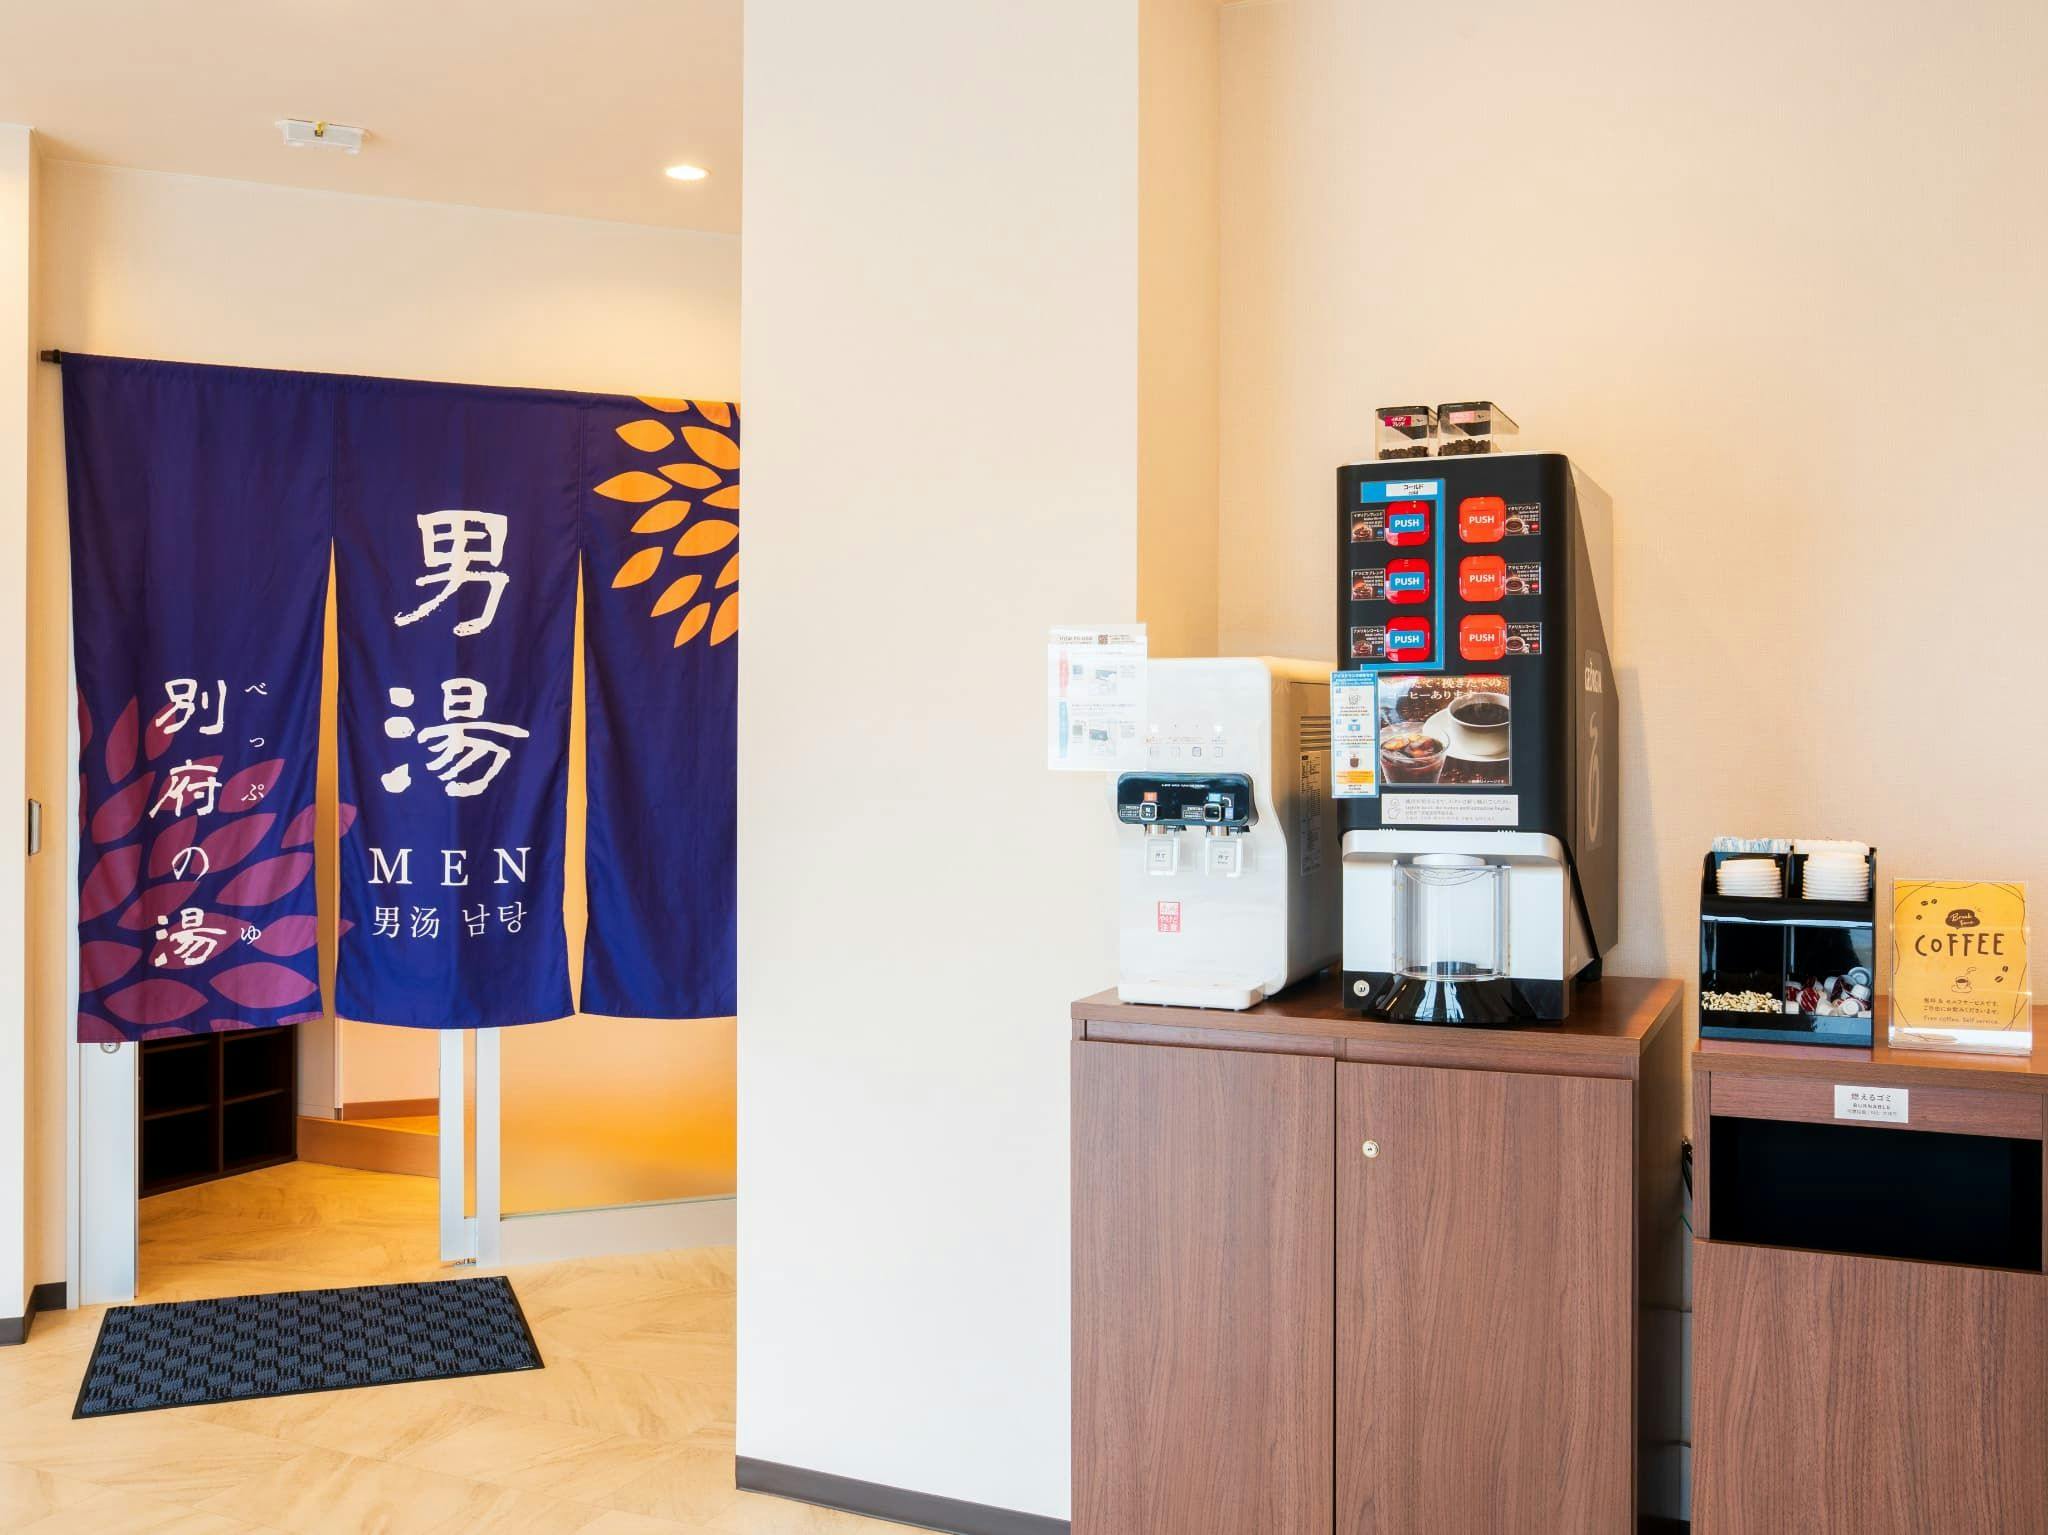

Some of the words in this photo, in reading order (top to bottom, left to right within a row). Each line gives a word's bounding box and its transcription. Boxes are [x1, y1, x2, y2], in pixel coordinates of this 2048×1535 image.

[1394, 519, 1420, 528] PUSH
[1469, 515, 1495, 524] PUSH
[1394, 577, 1420, 586] PUSH
[1469, 574, 1496, 583] PUSH
[1394, 635, 1420, 644] PUSH
[1469, 633, 1496, 643] PUSH
[381, 509, 530, 798] 男湯
[1396, 678, 1502, 690] たて・挽きたての
[1394, 690, 1473, 700] ーヒーあります
[149, 678, 227, 967] 別府の湯
[368, 847, 531, 886] MEN
[372, 905, 441, 939] 男汤
[462, 901, 527, 938] 남탕
[240, 925, 262, 945] ゆ
[1851, 1093, 1892, 1102] 燃えるゴミ
